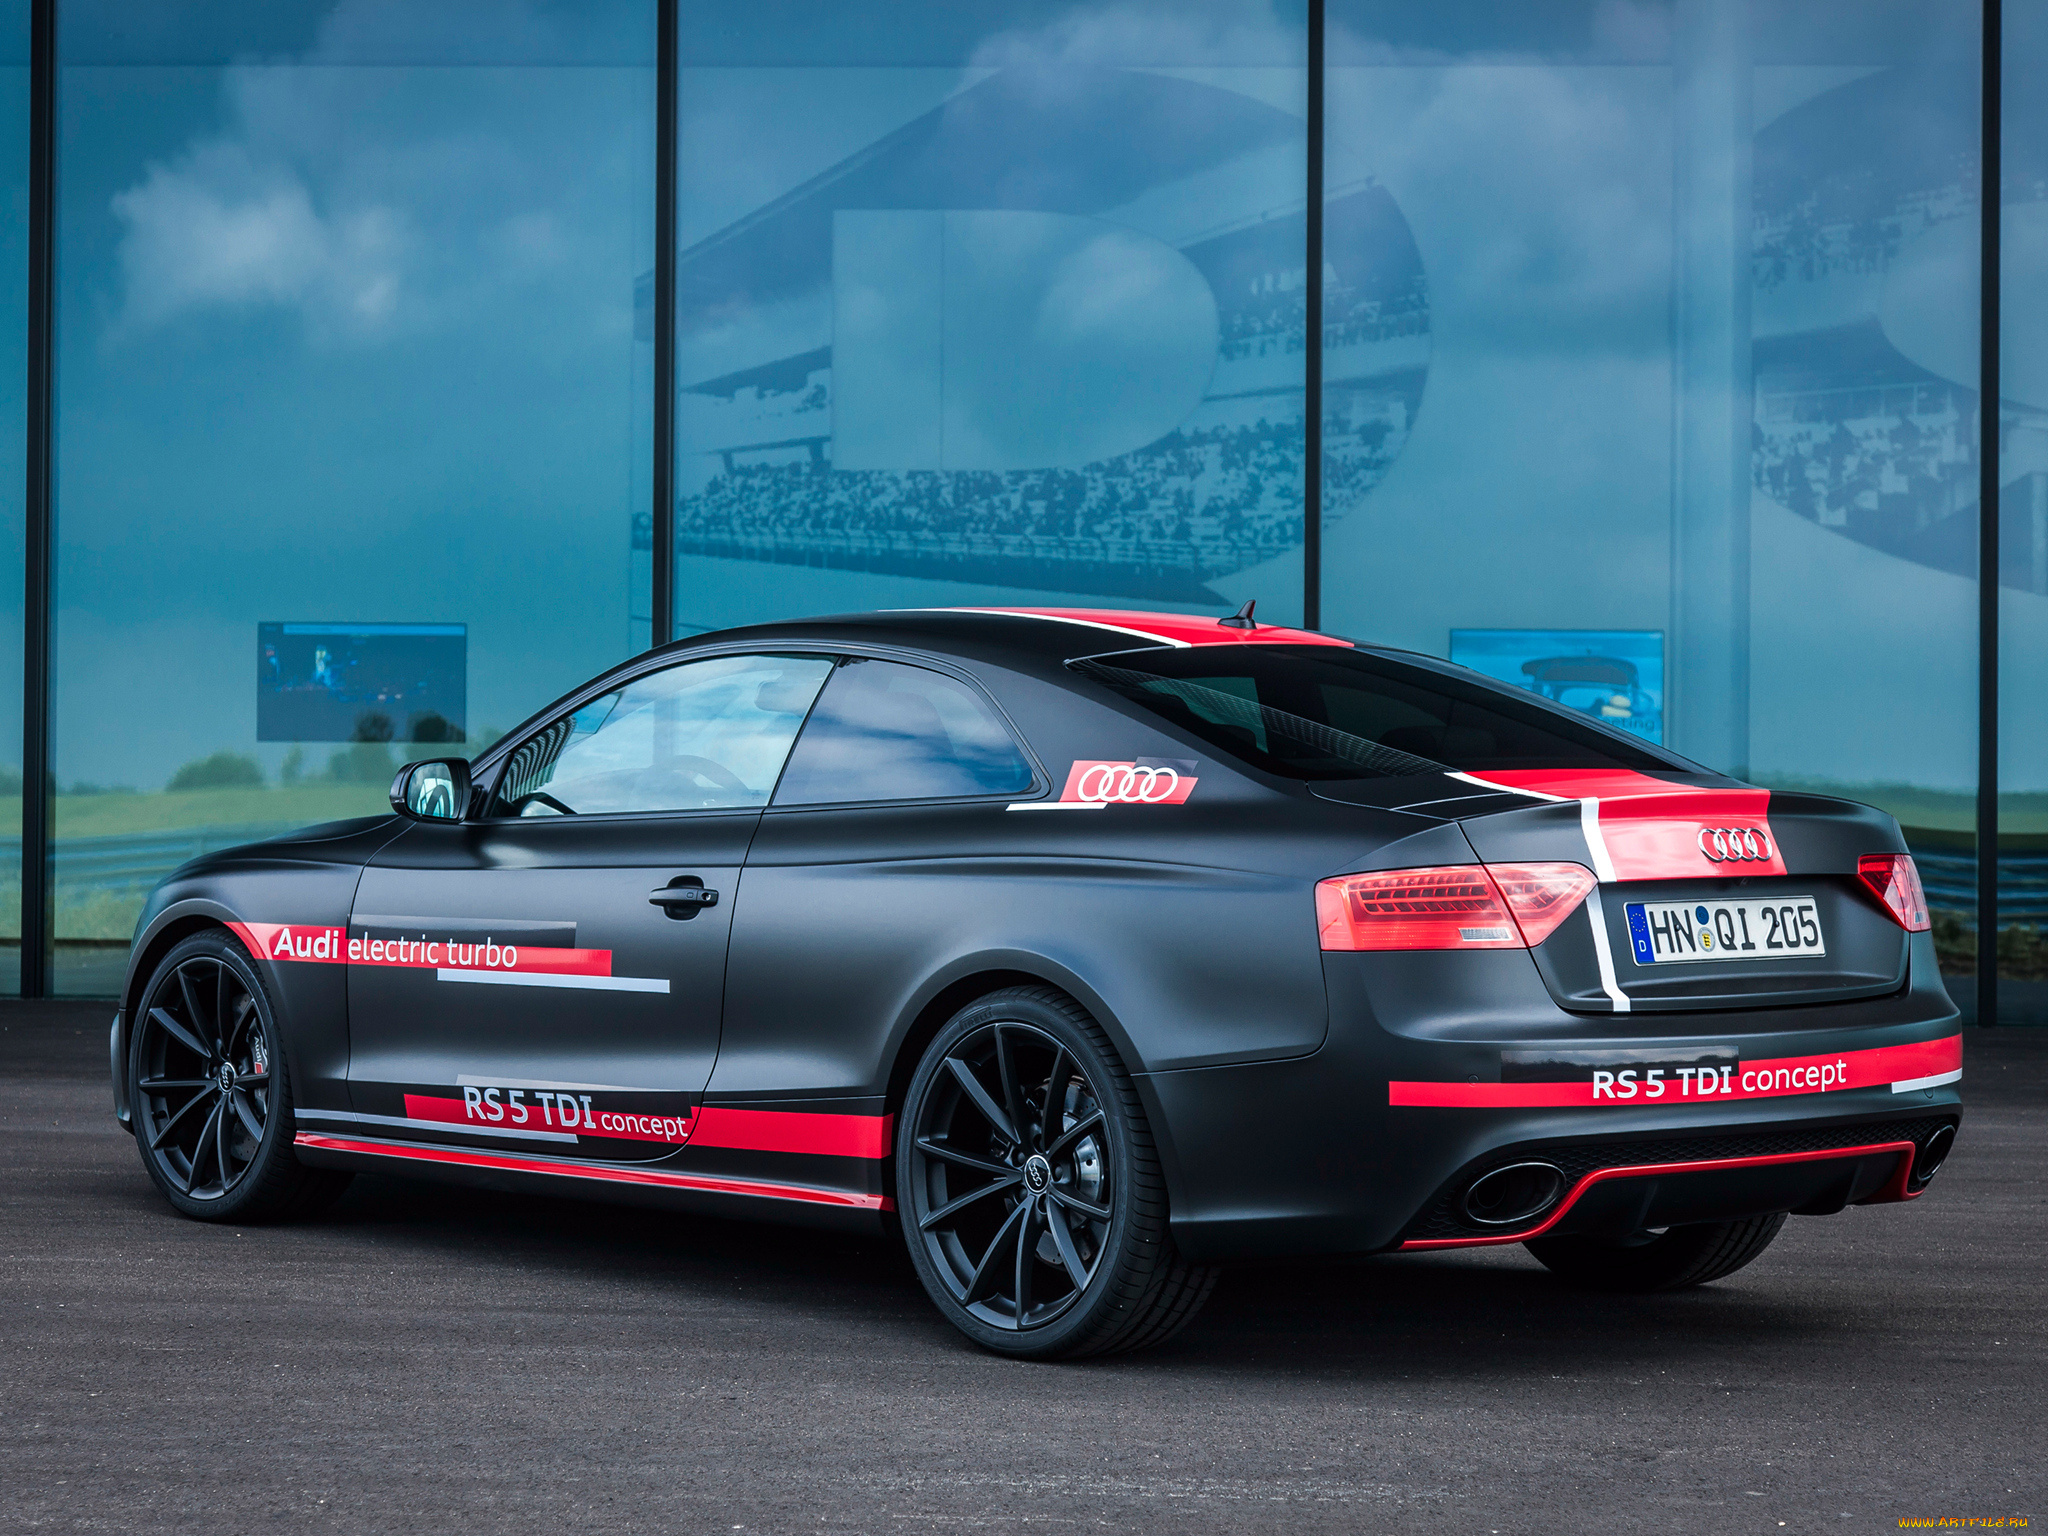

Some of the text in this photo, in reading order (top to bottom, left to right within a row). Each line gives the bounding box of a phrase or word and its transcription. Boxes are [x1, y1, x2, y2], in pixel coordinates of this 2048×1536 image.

[273, 928, 517, 968] Audi electric turbo
[1638, 940, 1647, 952] D
[1649, 905, 1818, 953] HN QI 205
[254, 1036, 262, 1062] Audi
[1593, 1059, 1847, 1098] RS 5 TDI concept
[463, 1086, 688, 1141] RS 5 TDI concept
